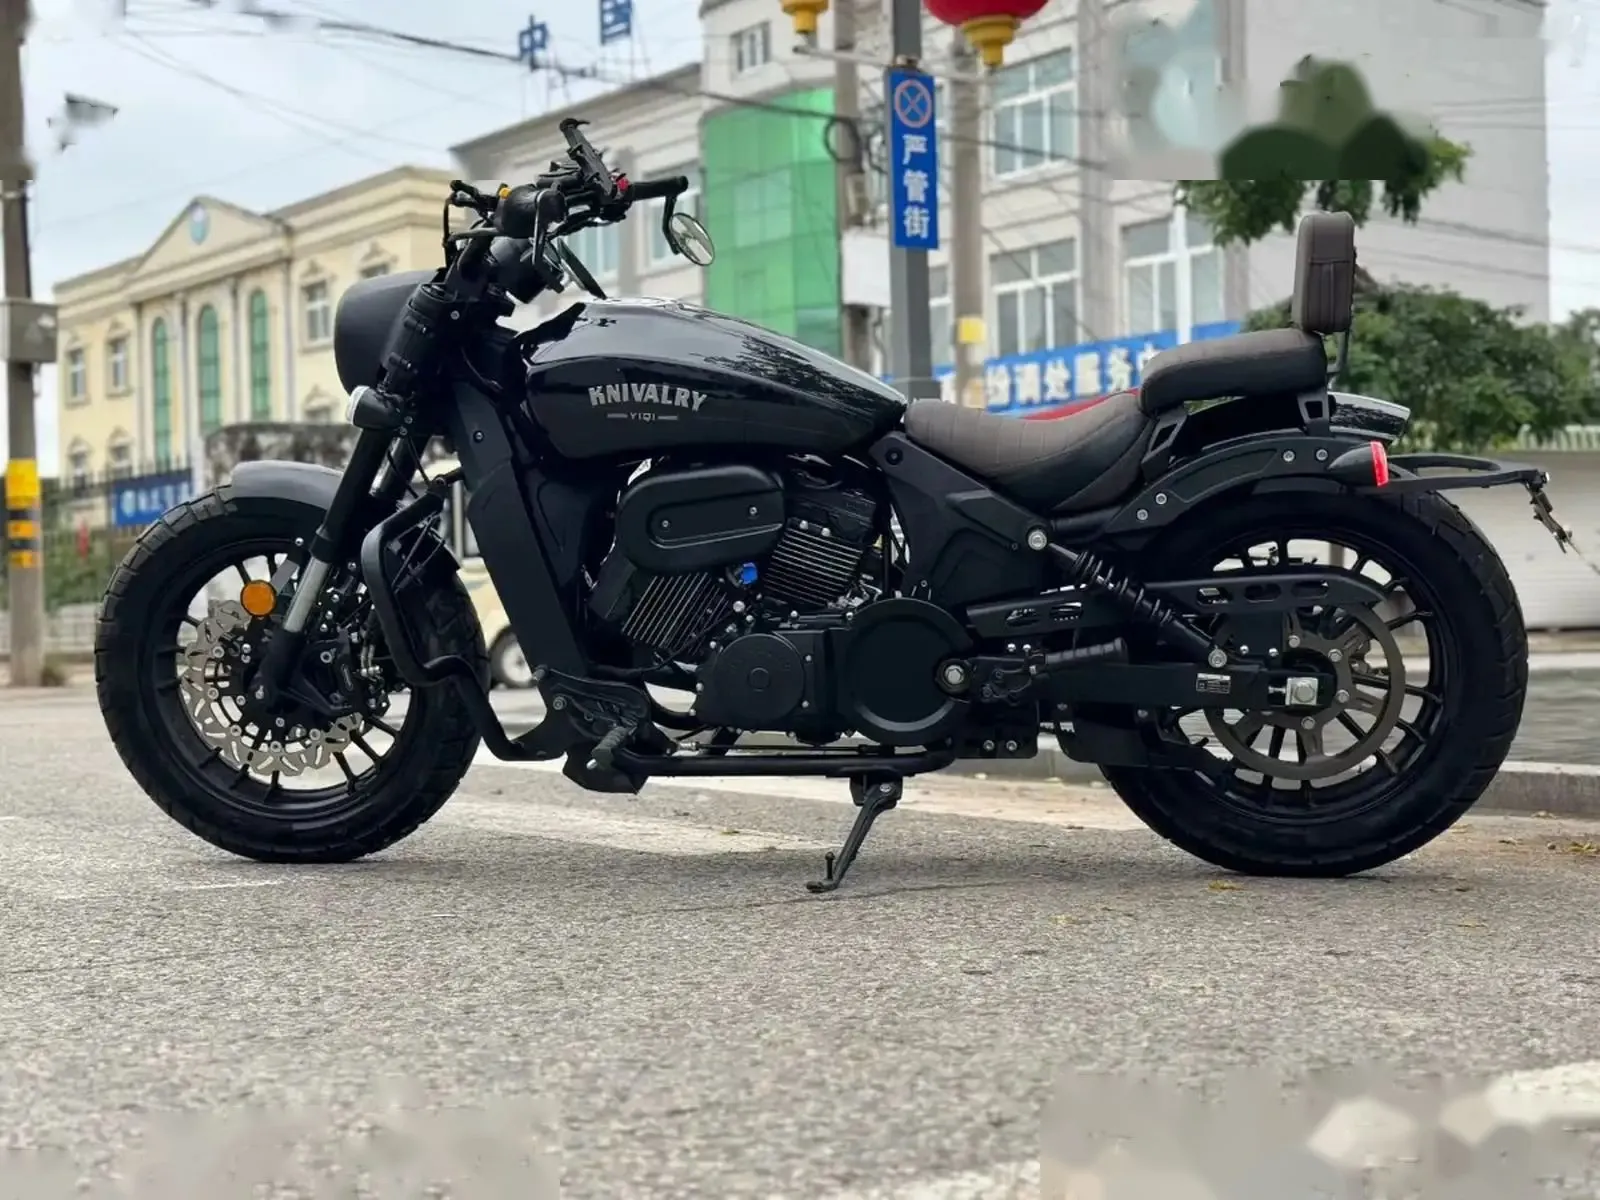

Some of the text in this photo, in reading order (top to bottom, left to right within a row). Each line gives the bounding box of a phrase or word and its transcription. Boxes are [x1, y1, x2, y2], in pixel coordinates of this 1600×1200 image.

[902, 134, 931, 239] 严管街
[588, 383, 707, 411] KNIVALRY
